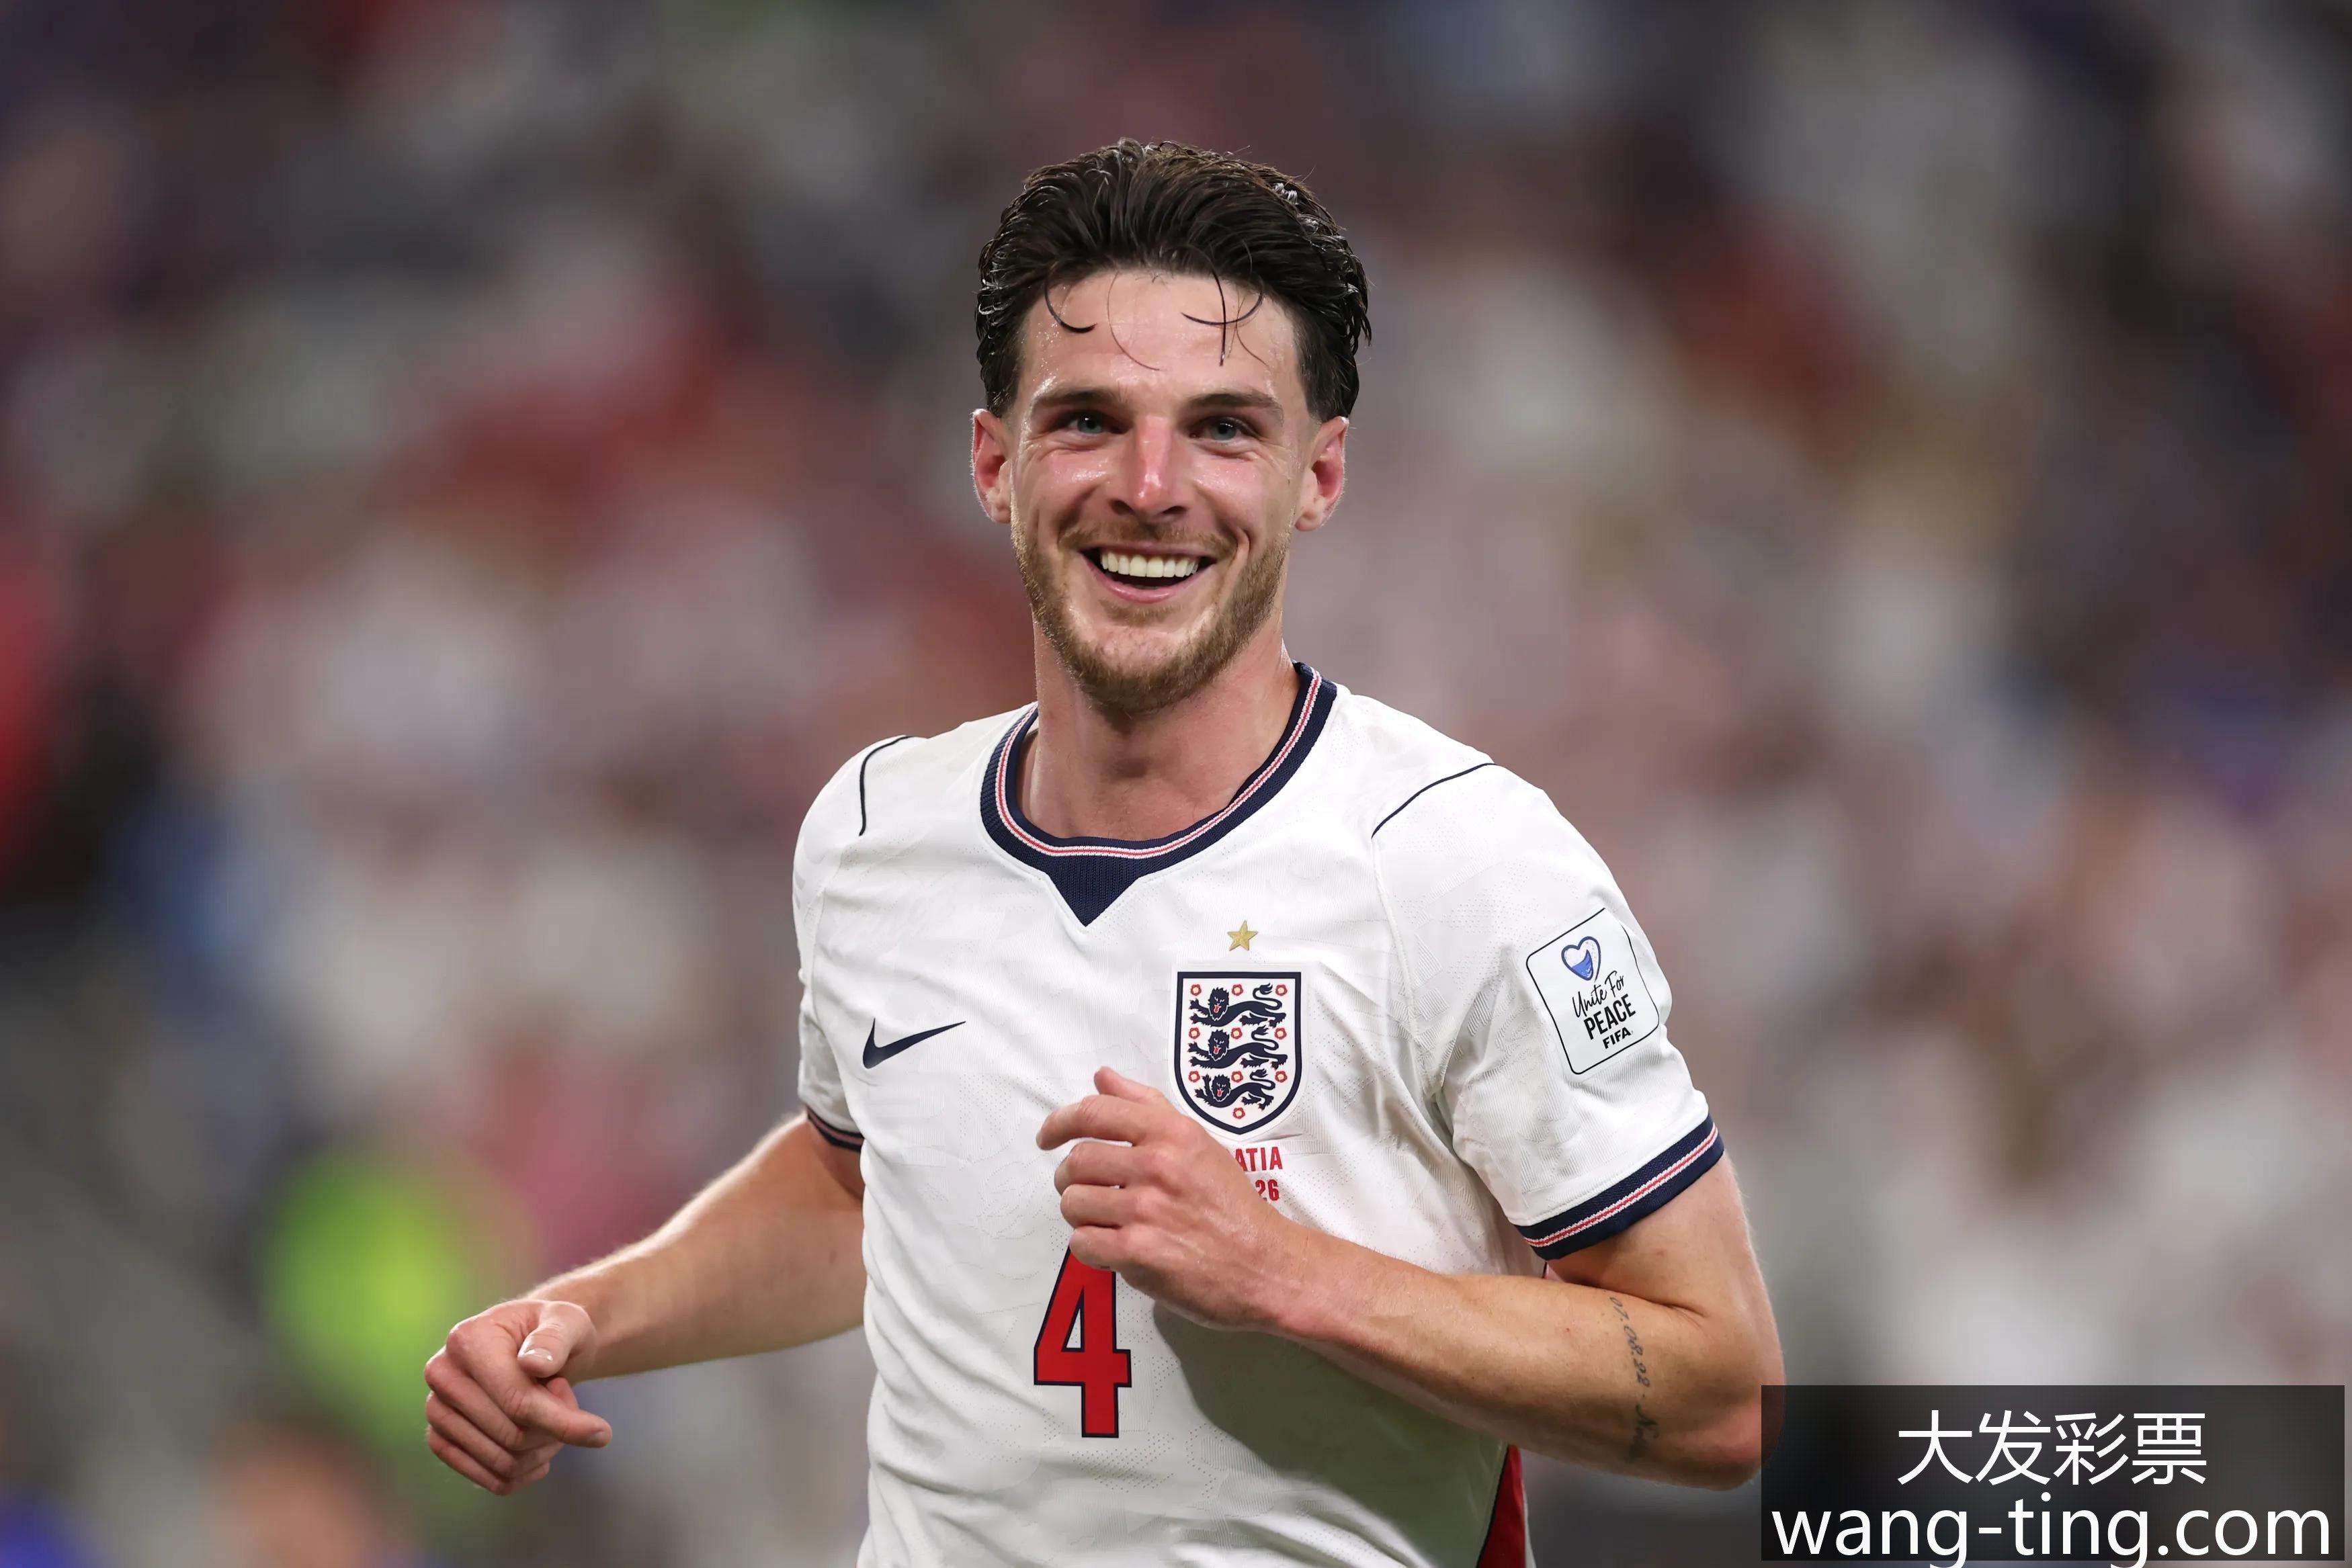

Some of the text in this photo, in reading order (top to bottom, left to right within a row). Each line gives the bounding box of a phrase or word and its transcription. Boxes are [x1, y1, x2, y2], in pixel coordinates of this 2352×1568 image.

[1572, 970, 1624, 1018] Unite For
[1583, 994, 1636, 1040] PEACE
[1602, 1027, 1632, 1049] FIFA
[1234, 1146, 1283, 1172] ATIA
[1034, 1244, 1132, 1438] 4
